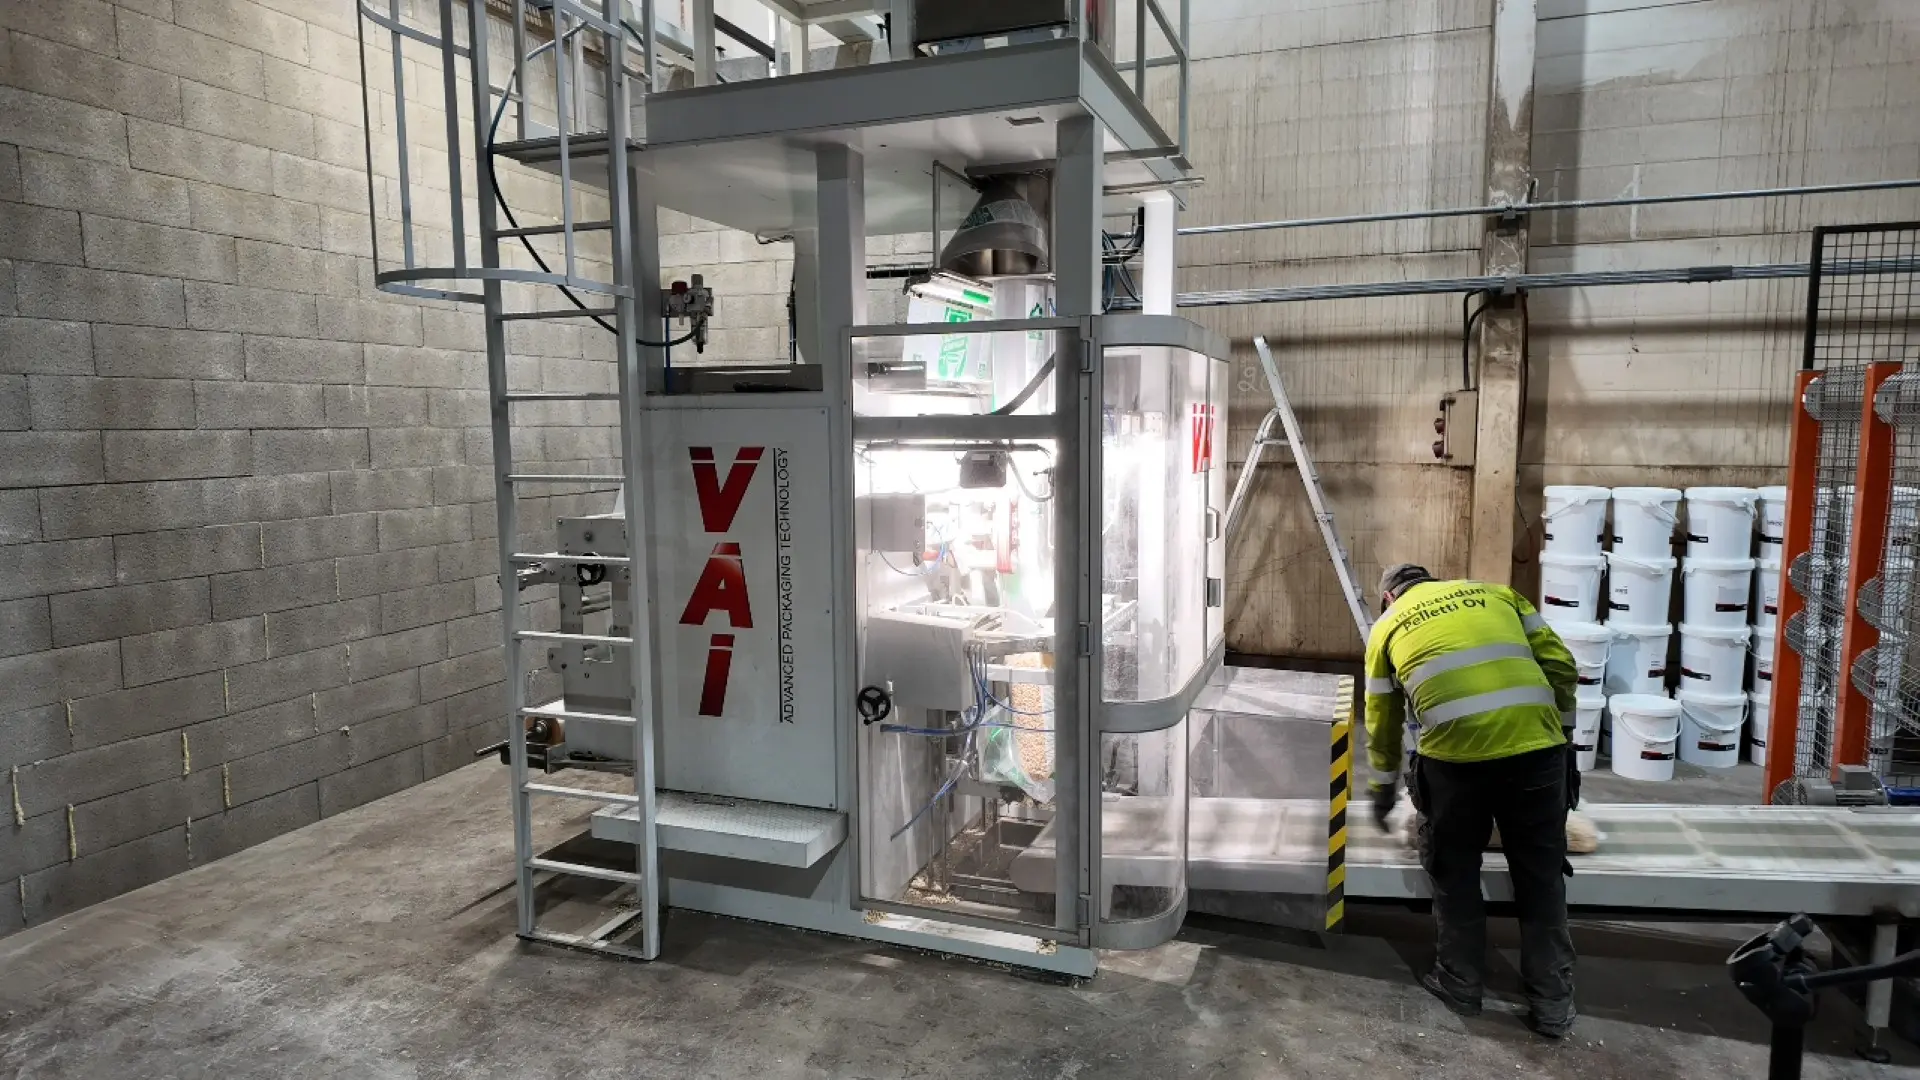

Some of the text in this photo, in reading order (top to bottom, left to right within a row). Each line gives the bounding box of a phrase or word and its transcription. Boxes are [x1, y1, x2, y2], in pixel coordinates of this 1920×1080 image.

[777, 448, 794, 724] ADVANCED PACKAGING TECHNOLOGY
[1402, 598, 1487, 632] Pelletti Oy
